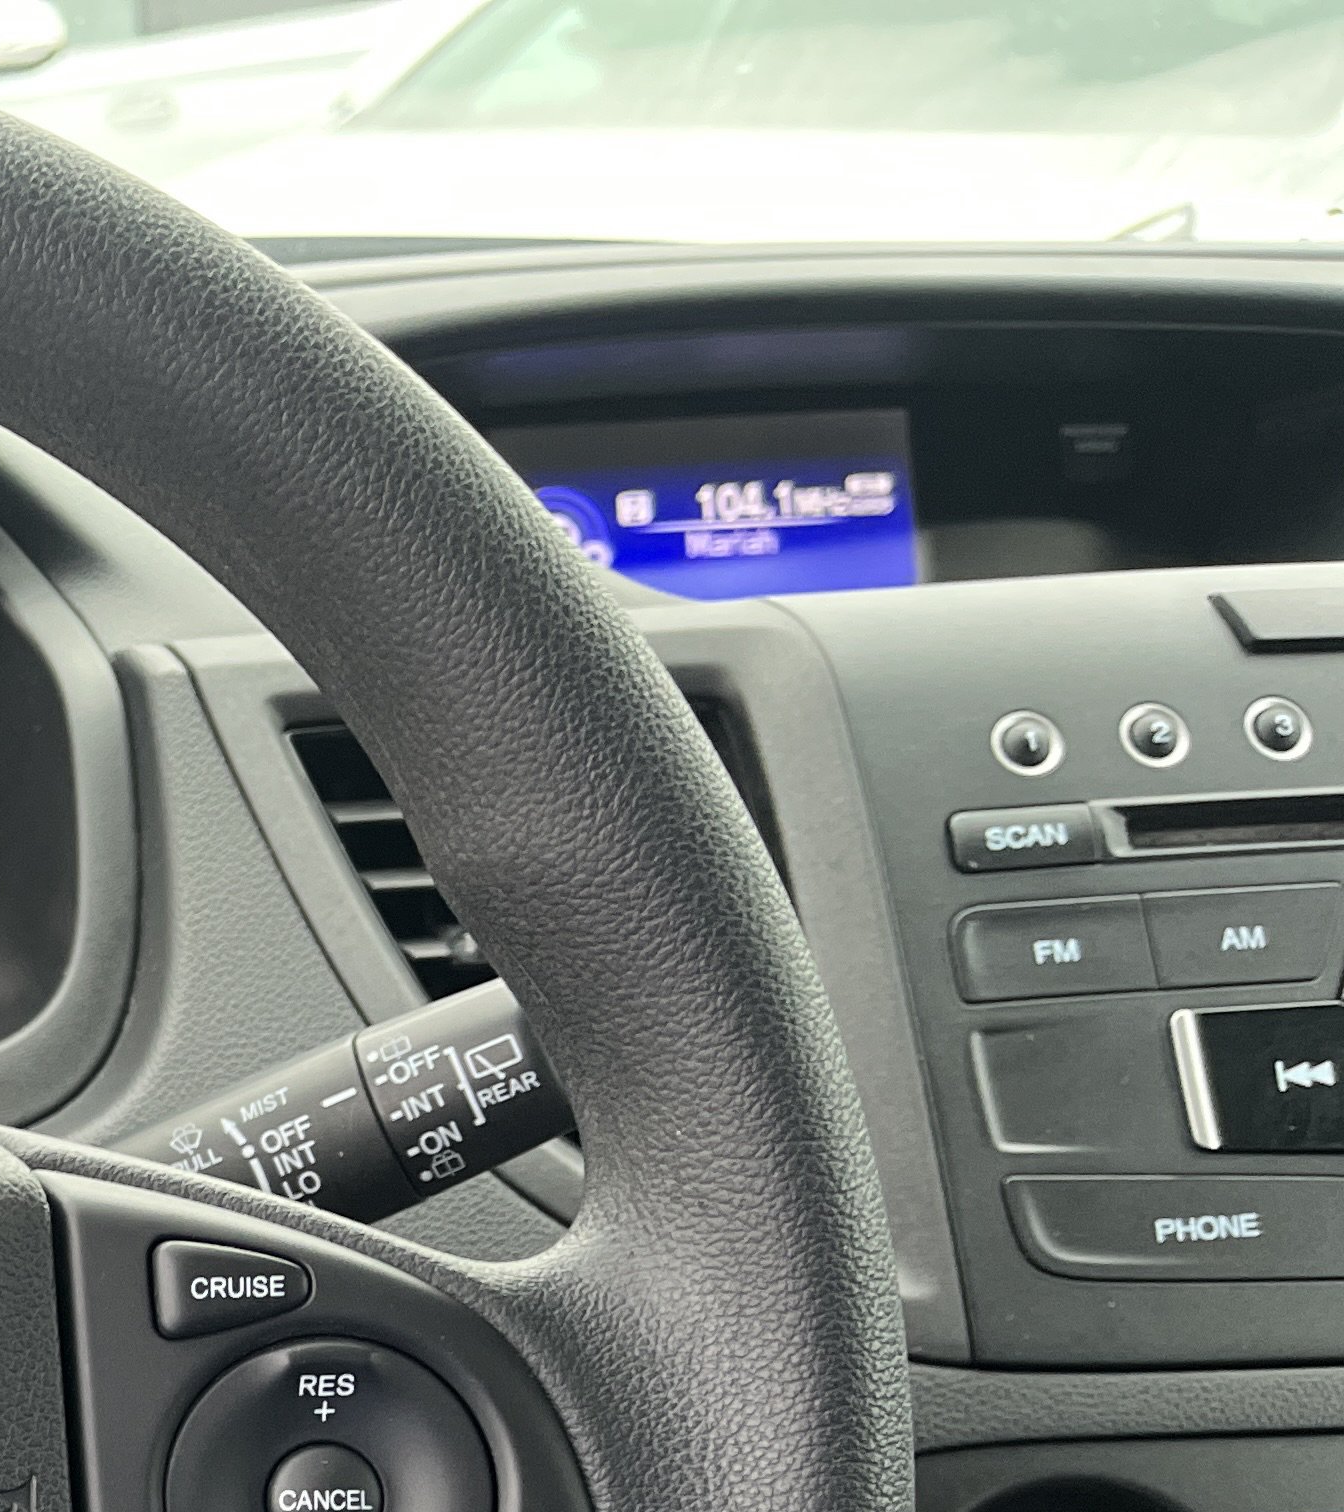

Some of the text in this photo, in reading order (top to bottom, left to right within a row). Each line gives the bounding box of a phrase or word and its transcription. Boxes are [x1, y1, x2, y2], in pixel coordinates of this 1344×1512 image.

[1150, 721, 1173, 744] 2
[1274, 714, 1295, 736] 3
[1023, 730, 1039, 752] 1
[984, 823, 1068, 851] SCAN
[1033, 938, 1082, 966] FM
[1220, 925, 1266, 952] AM
[385, 1045, 442, 1082] OFF
[240, 1086, 289, 1122] MIST
[399, 1083, 446, 1122] INT
[477, 1070, 540, 1109] REAR
[260, 1114, 312, 1153] OFF
[419, 1122, 464, 1155] ON
[273, 1140, 315, 1177] INT
[282, 1170, 321, 1200] LO
[1153, 1213, 1262, 1243] PHONE
[190, 1275, 285, 1299] CRUISE
[298, 1374, 355, 1397] RES
[278, 1489, 372, 1512] CANCEL
